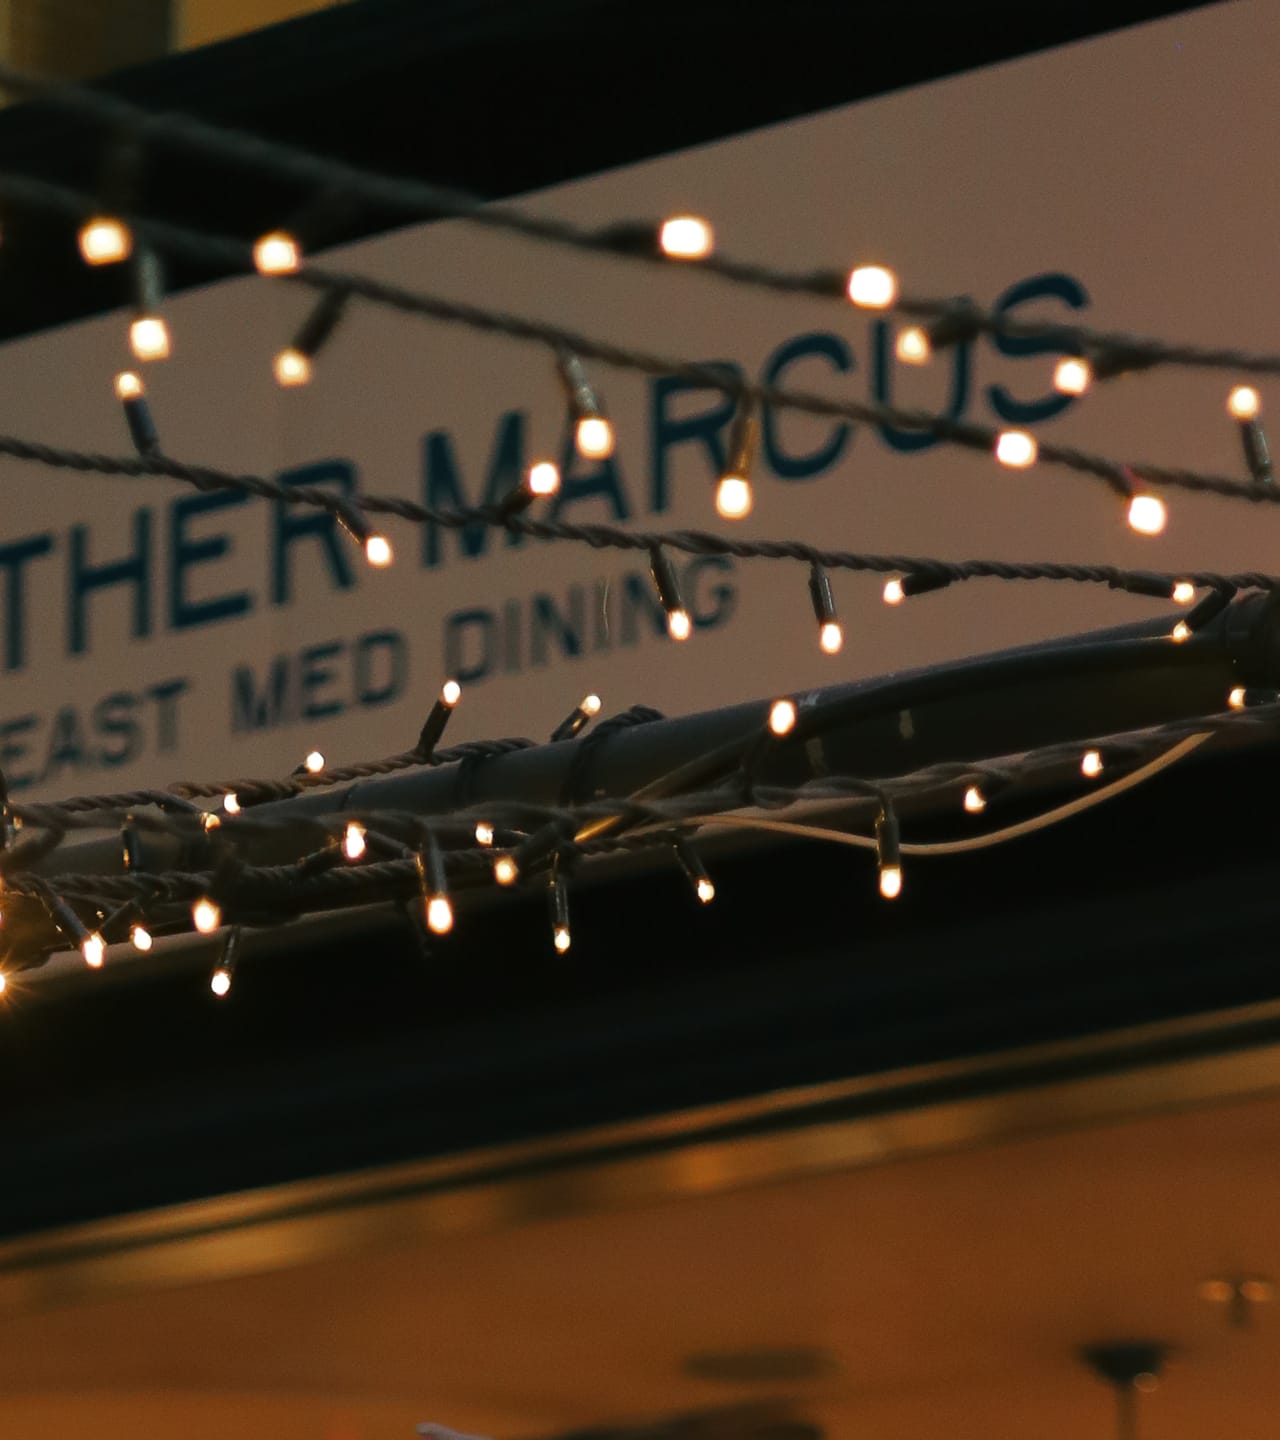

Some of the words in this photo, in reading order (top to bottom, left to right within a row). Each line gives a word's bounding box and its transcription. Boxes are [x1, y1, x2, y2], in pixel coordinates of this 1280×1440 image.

[422, 272, 1091, 567] MARCUS
[231, 630, 409, 735] MED
[444, 553, 735, 686] DINING
